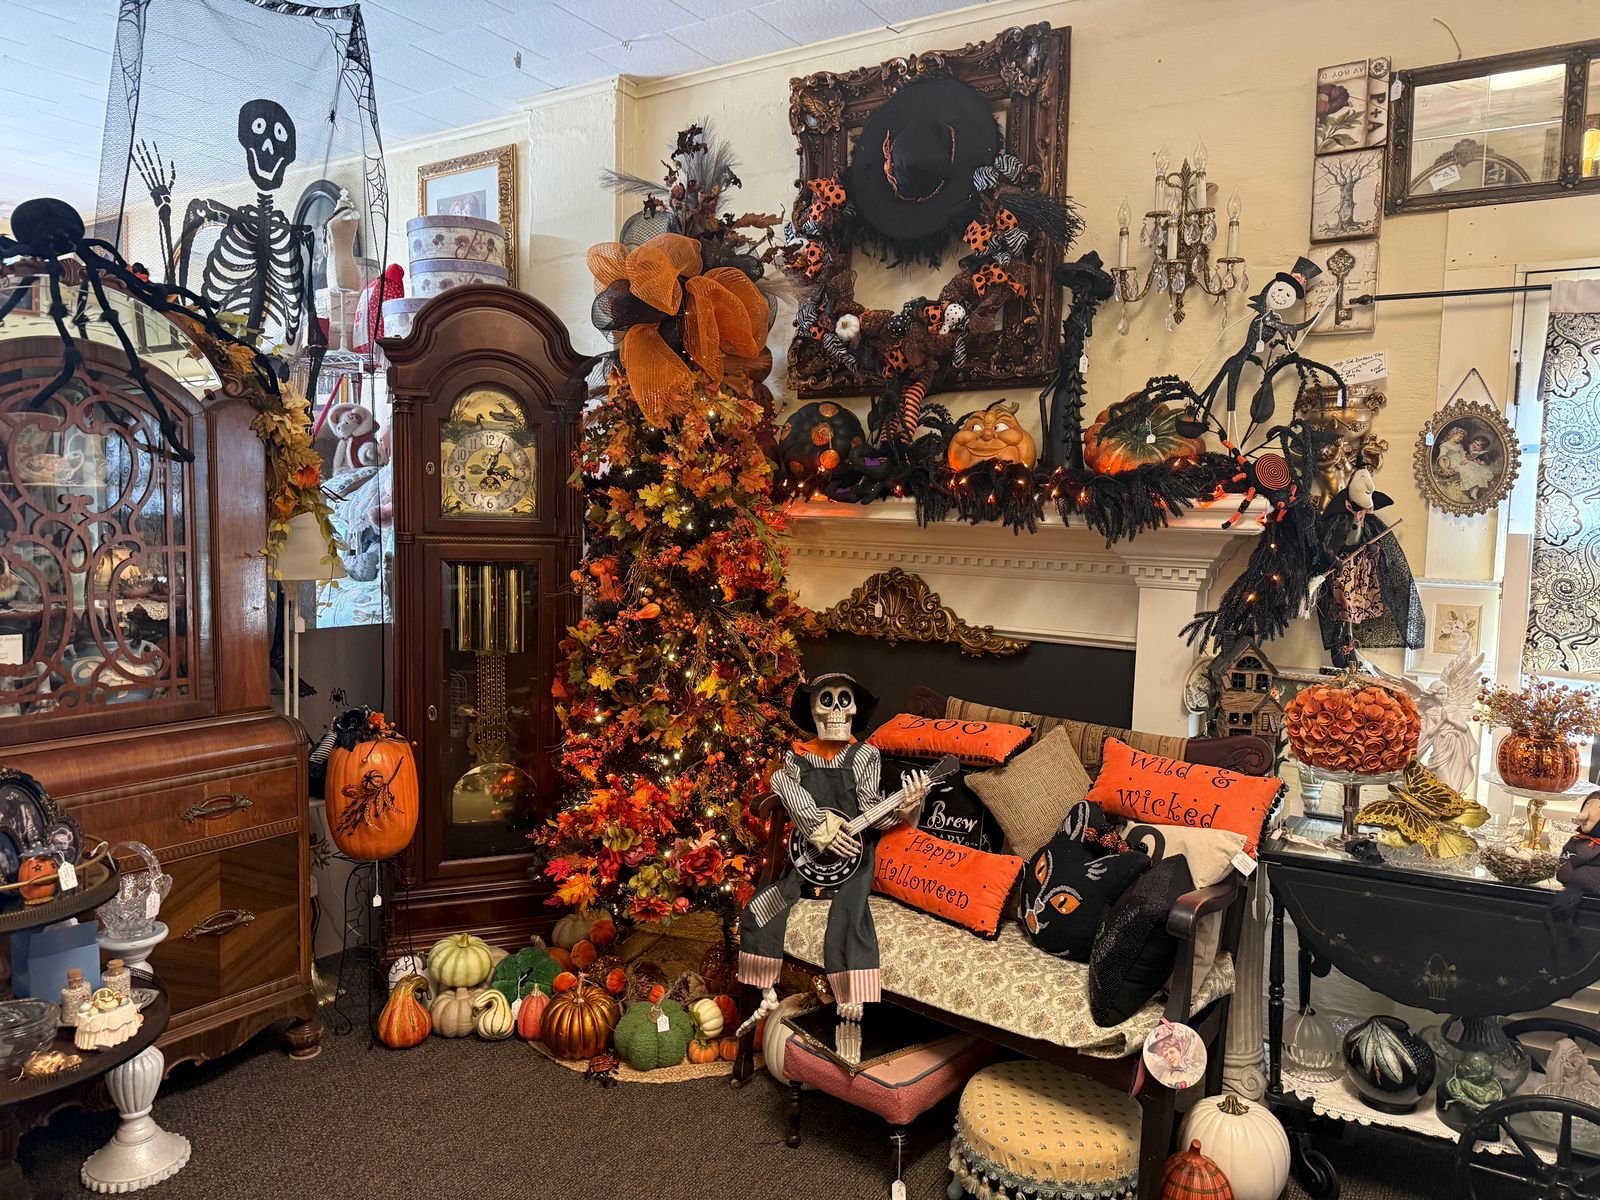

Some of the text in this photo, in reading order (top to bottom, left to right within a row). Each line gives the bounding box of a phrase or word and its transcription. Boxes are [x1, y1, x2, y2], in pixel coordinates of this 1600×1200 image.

[470, 439, 477, 449] 11
[486, 434, 496, 446] 12
[457, 449, 467, 460] 10
[453, 464, 461, 476] 9
[519, 467, 526, 478] 3
[458, 481, 466, 492] 8
[470, 492, 478, 504] 7
[486, 498, 494, 509] 6
[1211, 769, 1238, 789] &
[926, 800, 978, 833] Brew
[905, 835, 968, 868] Happy
[875, 858, 970, 910] Halloween
